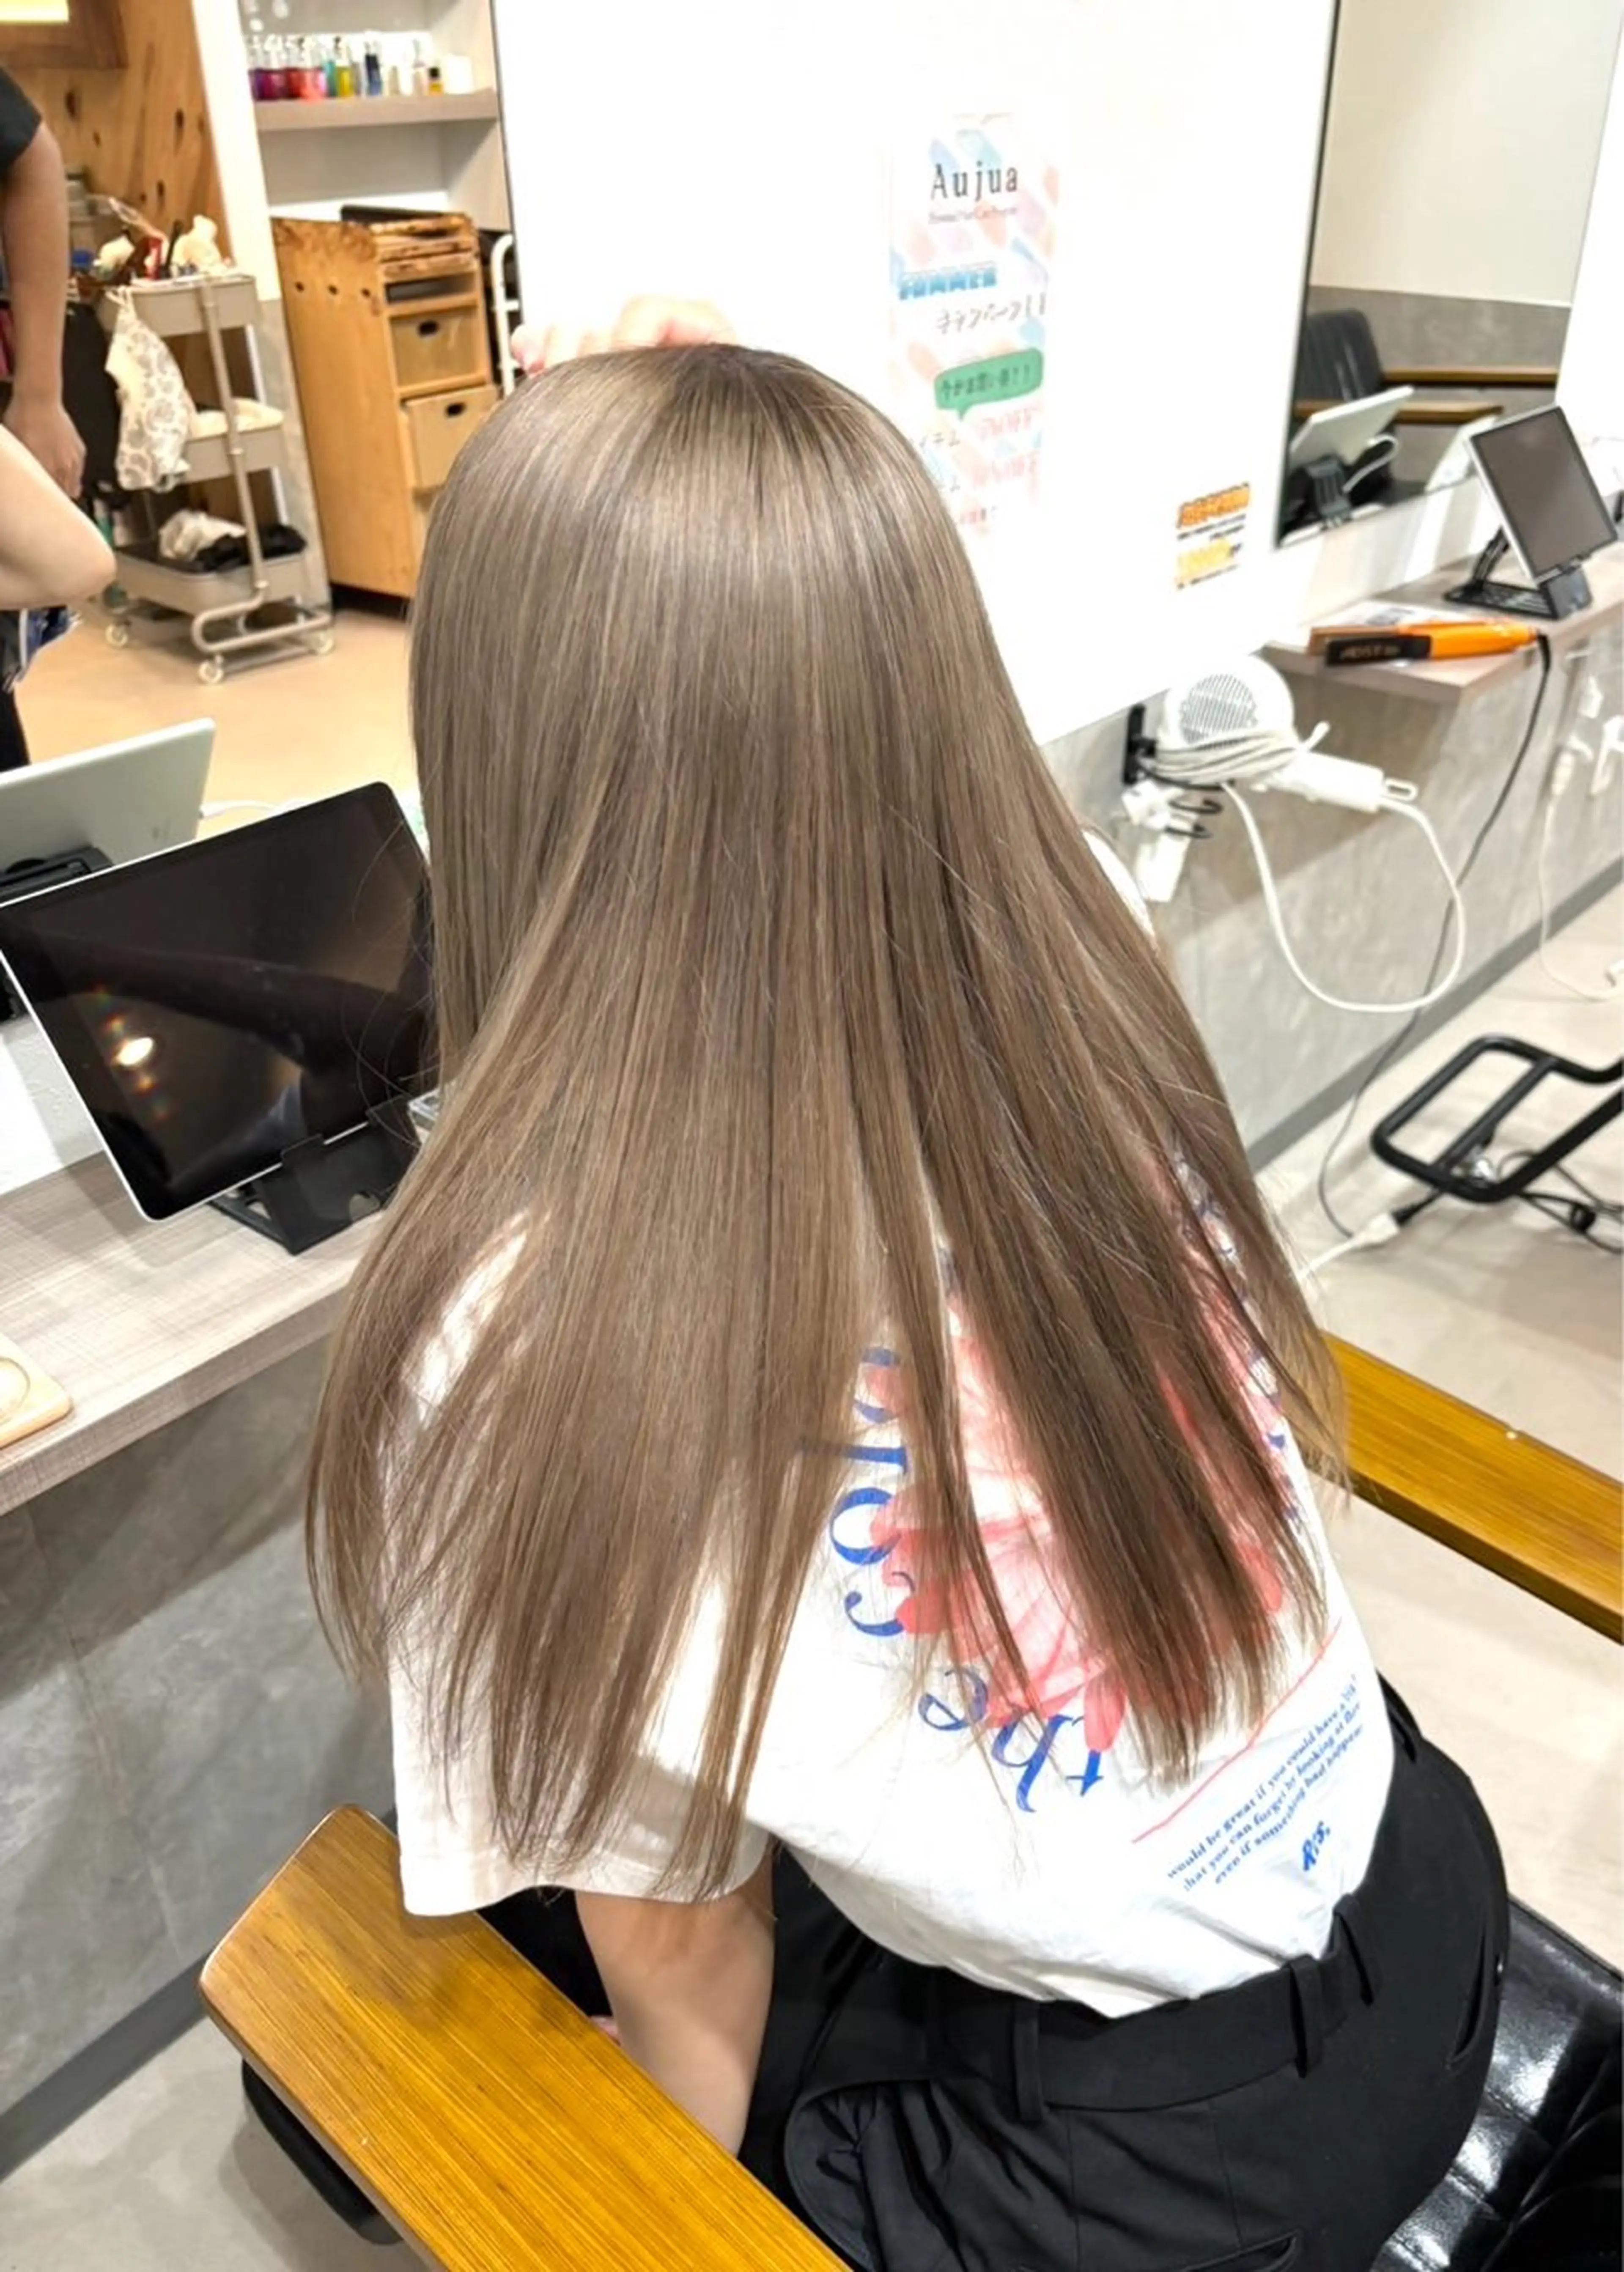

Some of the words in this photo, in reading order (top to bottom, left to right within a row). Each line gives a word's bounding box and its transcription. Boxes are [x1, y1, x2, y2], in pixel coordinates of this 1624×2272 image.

[930, 160, 1018, 202] Aujua
[1168, 1843, 1207, 1878] would
[1206, 1829, 1221, 1846] be
[1223, 1799, 1256, 1832] great
[1256, 1785, 1266, 1800] if
[1268, 1765, 1286, 1787] you
[1287, 1731, 1316, 1765] could
[1184, 1867, 1207, 1891] that
[1209, 1846, 1229, 1870] you
[1229, 1824, 1252, 1844] can
[1253, 1791, 1293, 1826] forget
[1215, 1856, 1240, 1884] even
[1240, 1841, 1251, 1856] if
